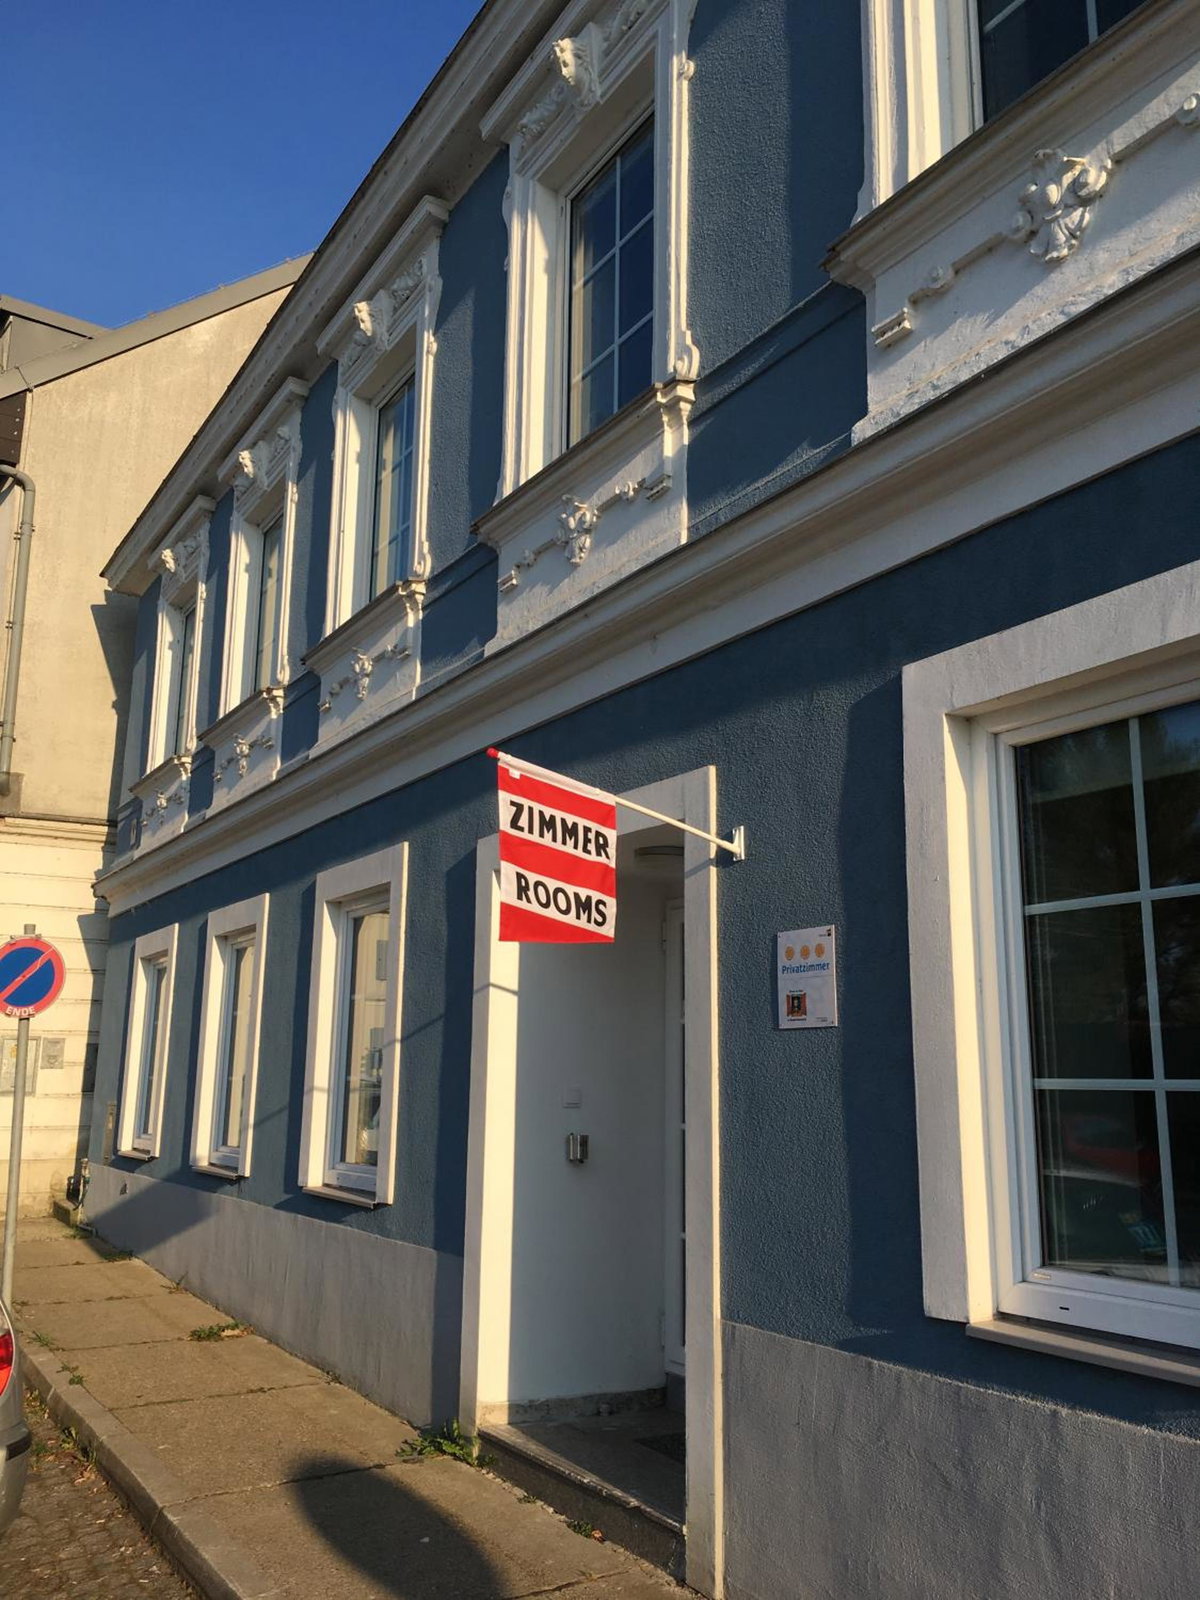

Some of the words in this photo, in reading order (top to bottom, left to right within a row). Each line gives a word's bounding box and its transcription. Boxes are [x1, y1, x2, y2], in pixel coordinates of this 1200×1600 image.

[509, 799, 611, 860] ZIMMER
[515, 871, 607, 928] ROOMS
[781, 962, 830, 975] Privatzimmer
[5, 1005, 36, 1016] ENDE
